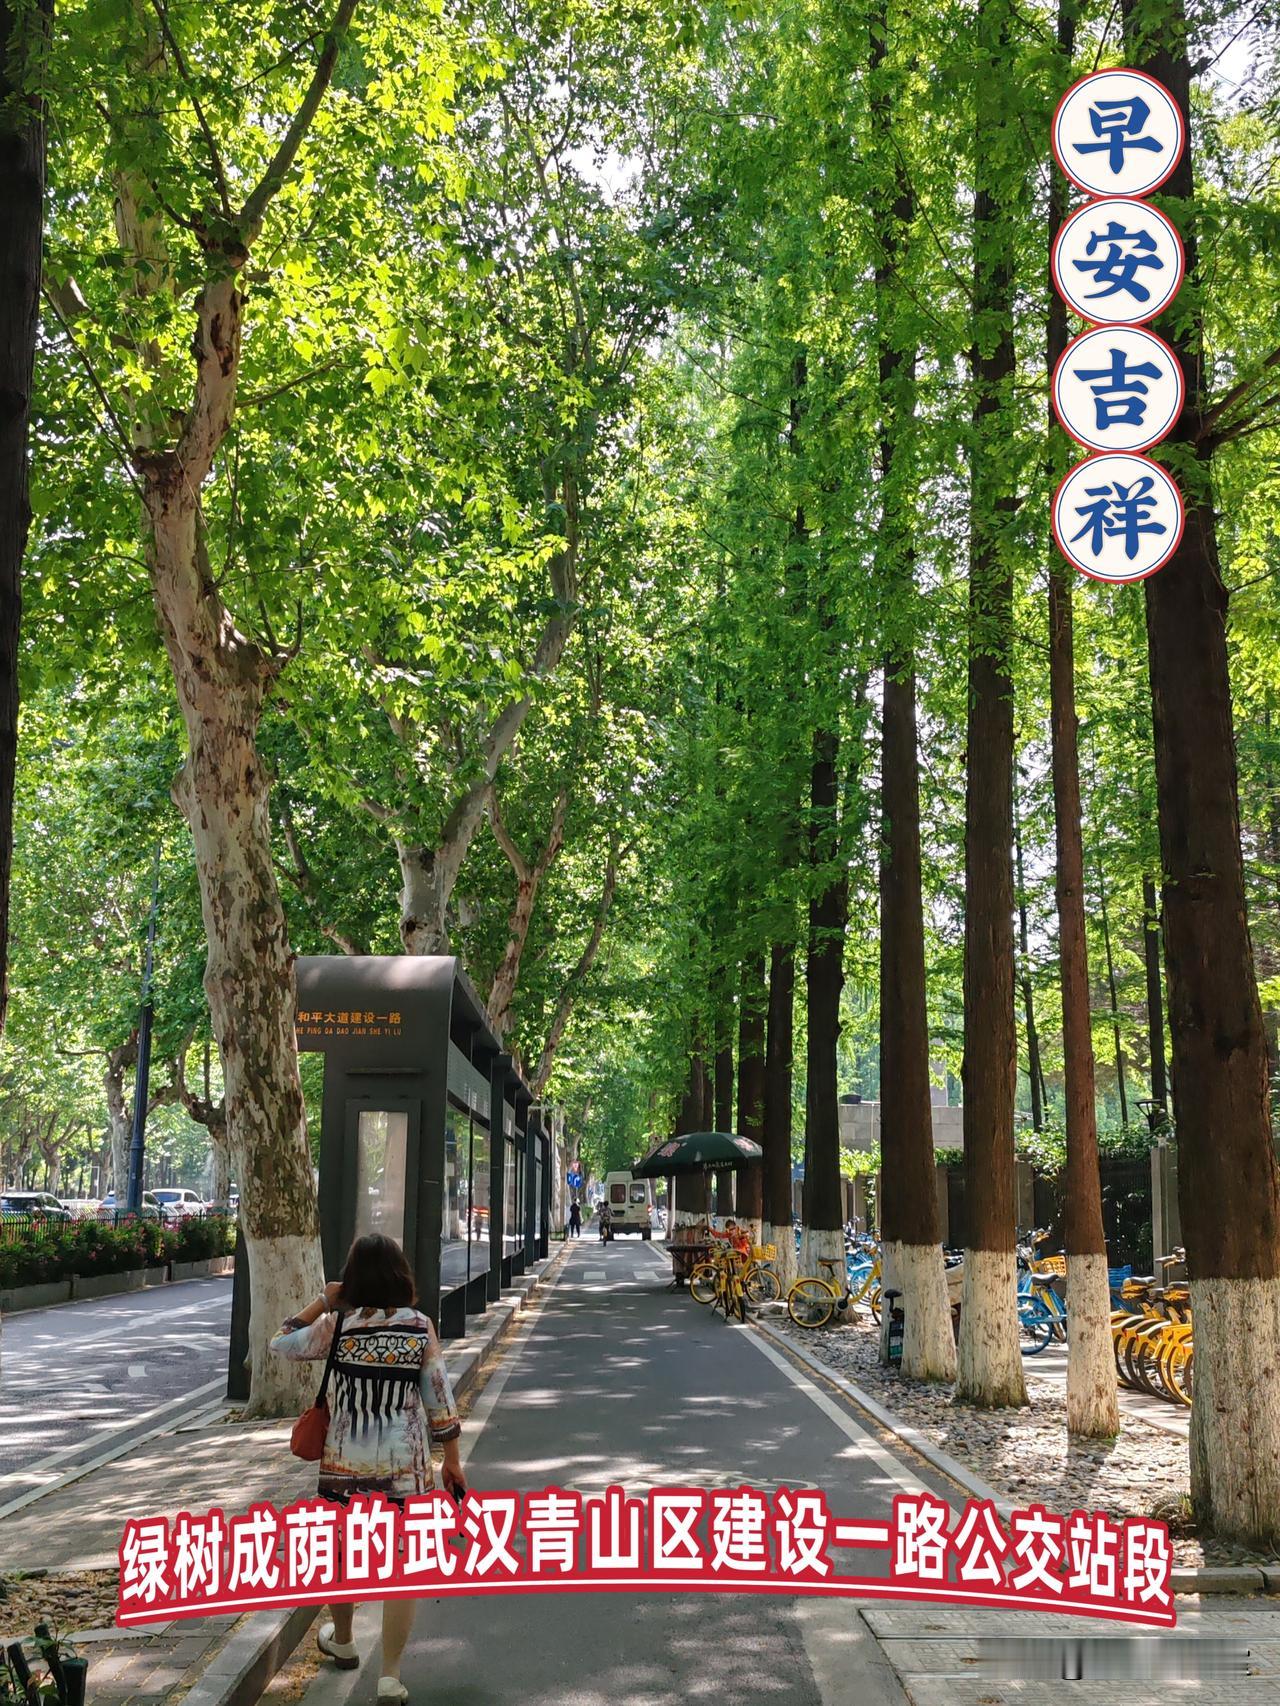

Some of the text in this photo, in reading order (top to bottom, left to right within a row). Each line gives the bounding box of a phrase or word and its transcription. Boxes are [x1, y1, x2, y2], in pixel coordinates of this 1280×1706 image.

[297, 1011, 401, 1024] 和平大道建设一路
[307, 1027, 321, 1035] PING
[325, 1027, 333, 1035] DA
[336, 1027, 349, 1035] DAO
[352, 1027, 366, 1035] JIAN
[370, 1027, 381, 1035] SHE
